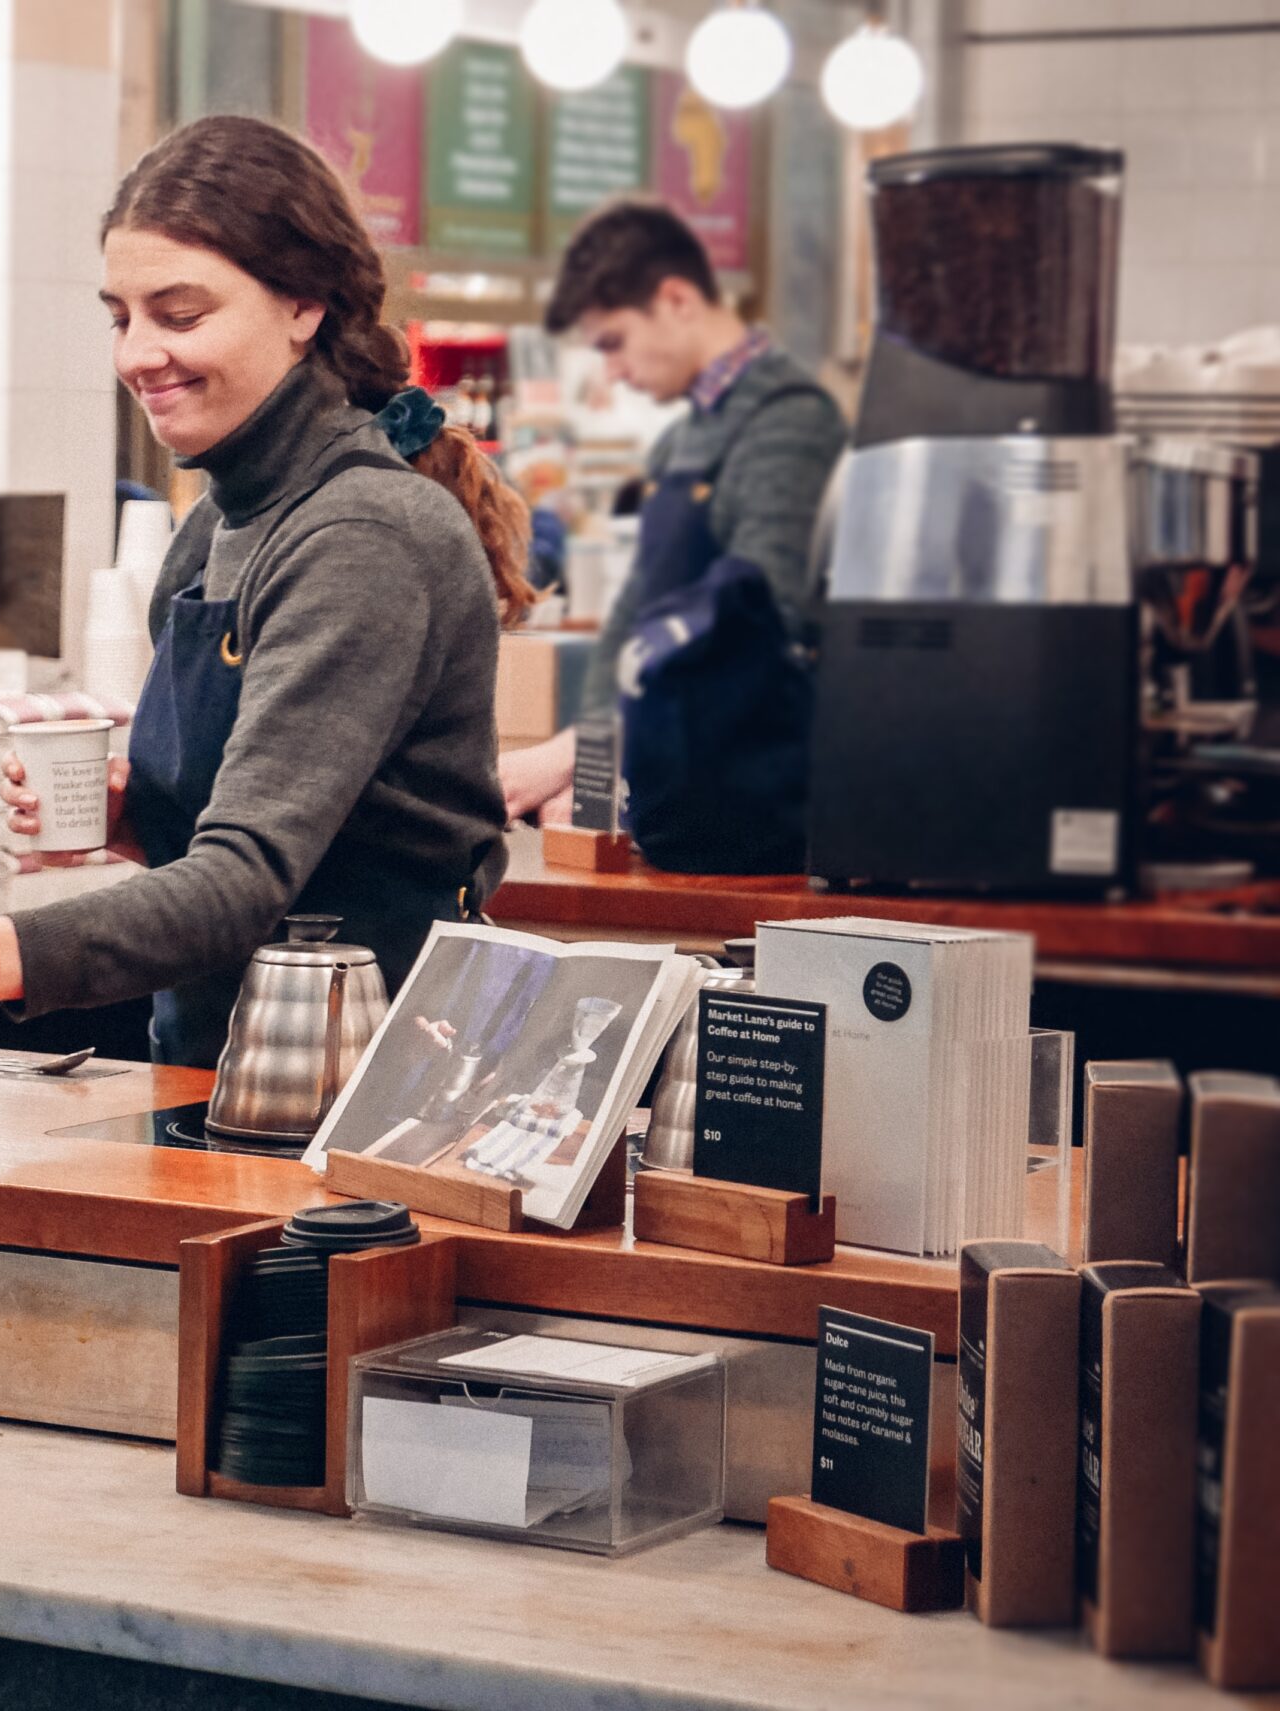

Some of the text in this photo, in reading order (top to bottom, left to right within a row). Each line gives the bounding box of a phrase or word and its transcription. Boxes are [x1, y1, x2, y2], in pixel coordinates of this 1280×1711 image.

[707, 1009, 815, 1031] Market Lane's guide to
[707, 1025, 780, 1043] Coffee at Home
[706, 1051, 798, 1075] Our simple step-by-
[706, 1071, 803, 1095] step guide to making
[705, 1089, 804, 1111] great coffee at home.
[704, 1129, 721, 1141] $10
[825, 1332, 849, 1348] Dulce
[825, 1358, 897, 1387] Made from organic
[824, 1377, 906, 1407] sugar-cane juice, this
[823, 1394, 914, 1427] soft and crumbly sugar
[822, 1408, 912, 1444] has notes of caramel &
[822, 1427, 860, 1446] molasses.
[820, 1456, 834, 1470] $11
